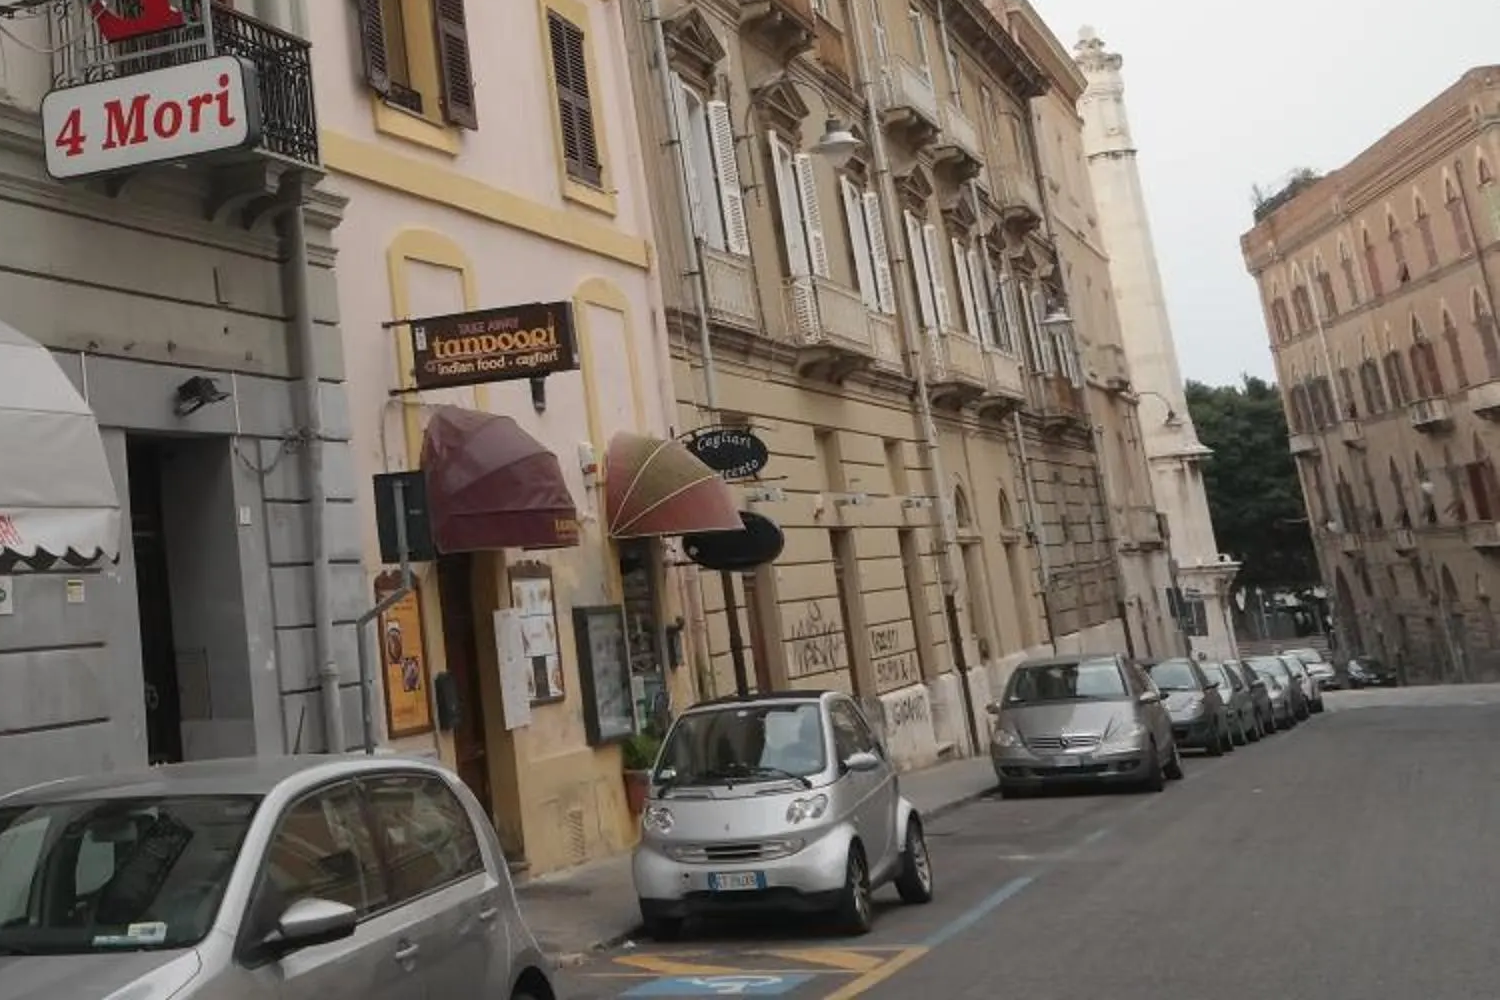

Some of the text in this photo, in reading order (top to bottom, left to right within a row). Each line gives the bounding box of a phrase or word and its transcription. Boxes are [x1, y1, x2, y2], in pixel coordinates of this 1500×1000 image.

[55, 73, 236, 157] 4 Mori
[477, 356, 505, 372] food
